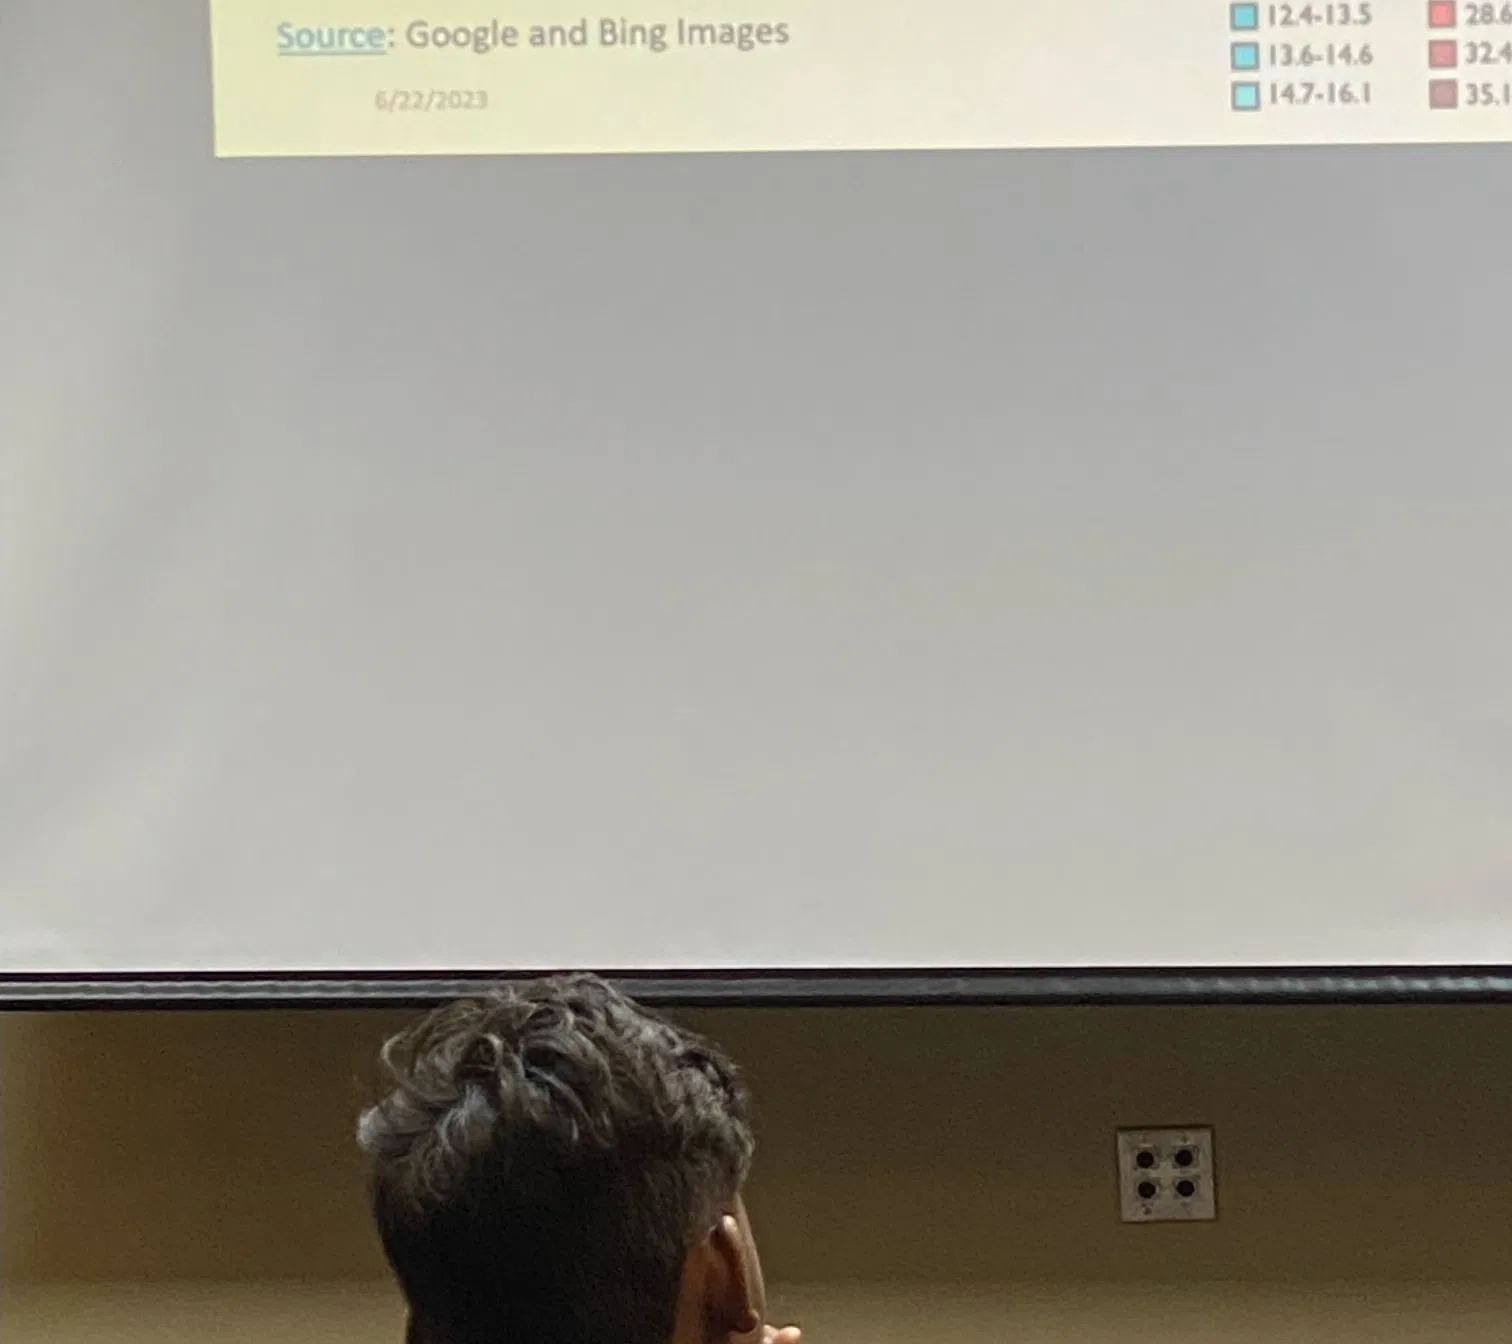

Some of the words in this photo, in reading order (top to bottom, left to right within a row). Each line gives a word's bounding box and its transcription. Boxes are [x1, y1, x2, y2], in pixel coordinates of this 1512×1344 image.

[1268, 4, 1373, 27] 12.4-13.5
[276, 21, 395, 55] Source:
[405, 20, 519, 53] Google
[529, 19, 588, 49] and
[599, 19, 667, 52] Bing
[678, 19, 790, 52] Images
[1268, 43, 1374, 66] 13.6-14.6
[374, 88, 488, 112] 6/22/2023
[1268, 82, 1372, 105] 14.7-16.1
